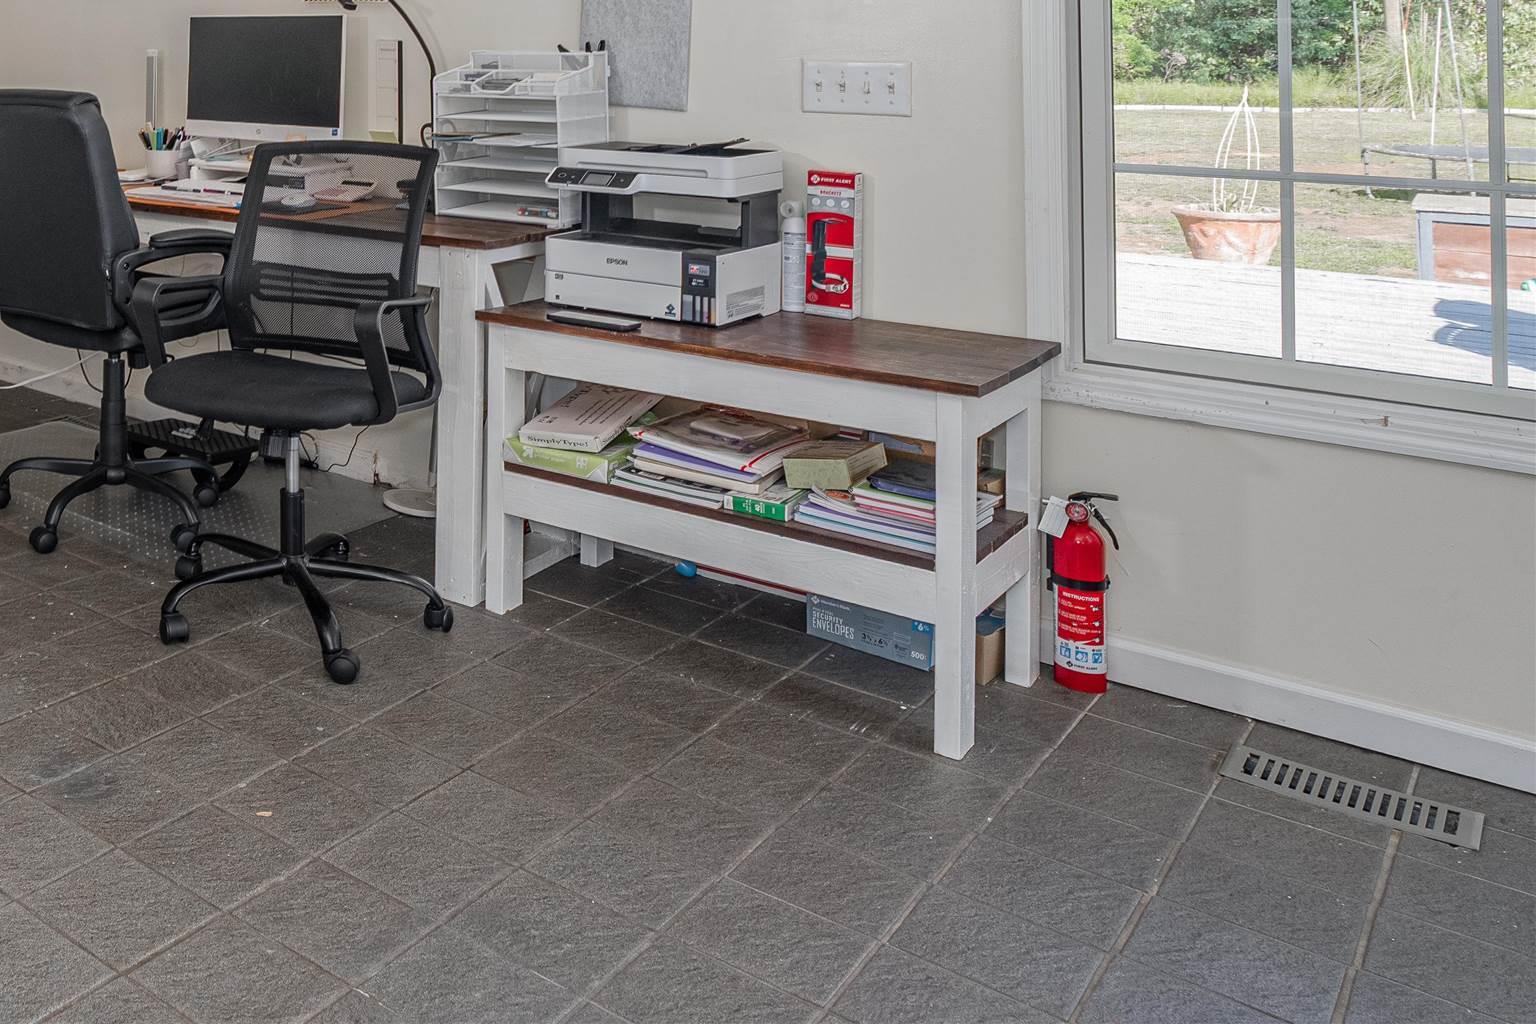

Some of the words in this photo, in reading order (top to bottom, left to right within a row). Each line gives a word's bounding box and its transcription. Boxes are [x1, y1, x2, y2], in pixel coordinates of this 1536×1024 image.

[606, 257, 628, 266] EPSON
[1062, 591, 1100, 602] INSTRUCTIONS
[812, 610, 843, 625] SECURITY
[812, 616, 855, 640] ENVELOPES
